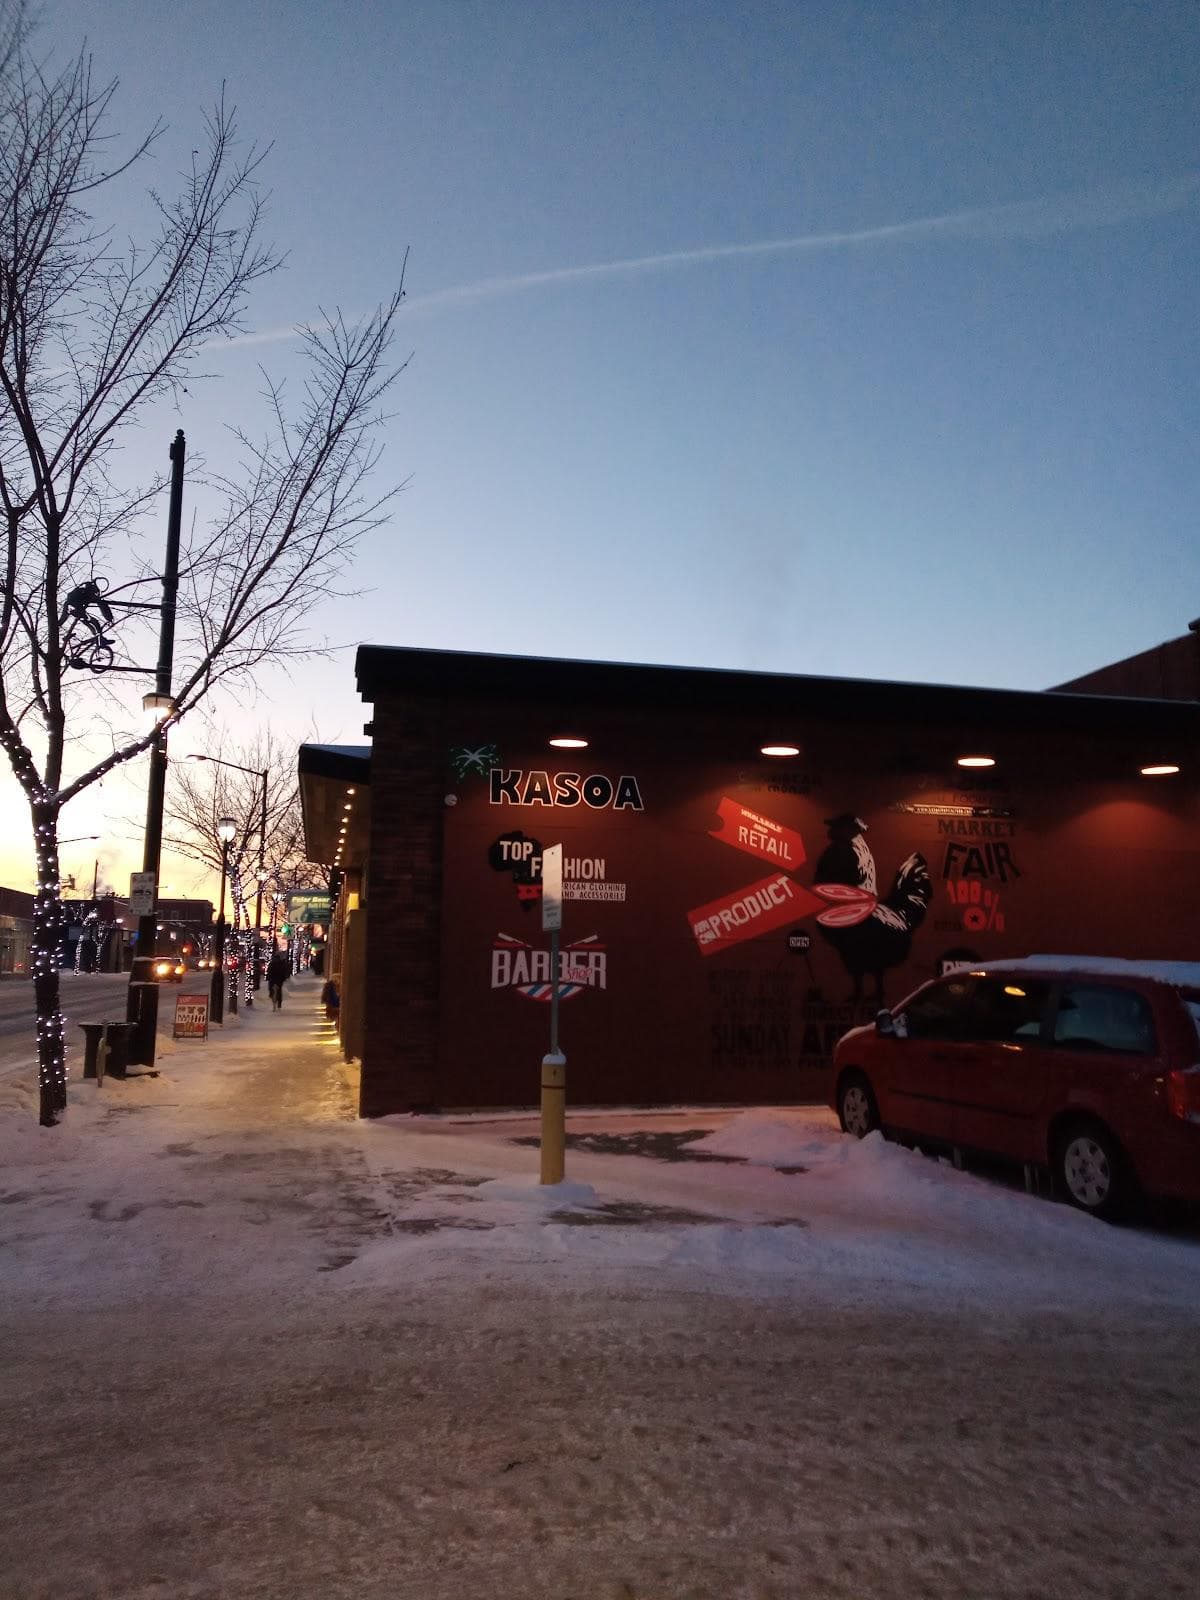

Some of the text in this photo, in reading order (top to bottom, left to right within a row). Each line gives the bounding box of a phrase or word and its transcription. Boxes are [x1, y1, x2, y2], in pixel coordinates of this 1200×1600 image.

[490, 768, 645, 811] KASOA
[937, 817, 1017, 837] MARKET
[499, 840, 534, 861] TOP
[739, 825, 792, 861] RETAIL
[530, 856, 606, 880] FHION
[943, 840, 1022, 884] FAIR
[580, 891, 626, 900] ACCESSORIES
[589, 883, 626, 892] CLOTHING
[708, 875, 794, 938] PRODUCT
[491, 950, 607, 990] BARBER
